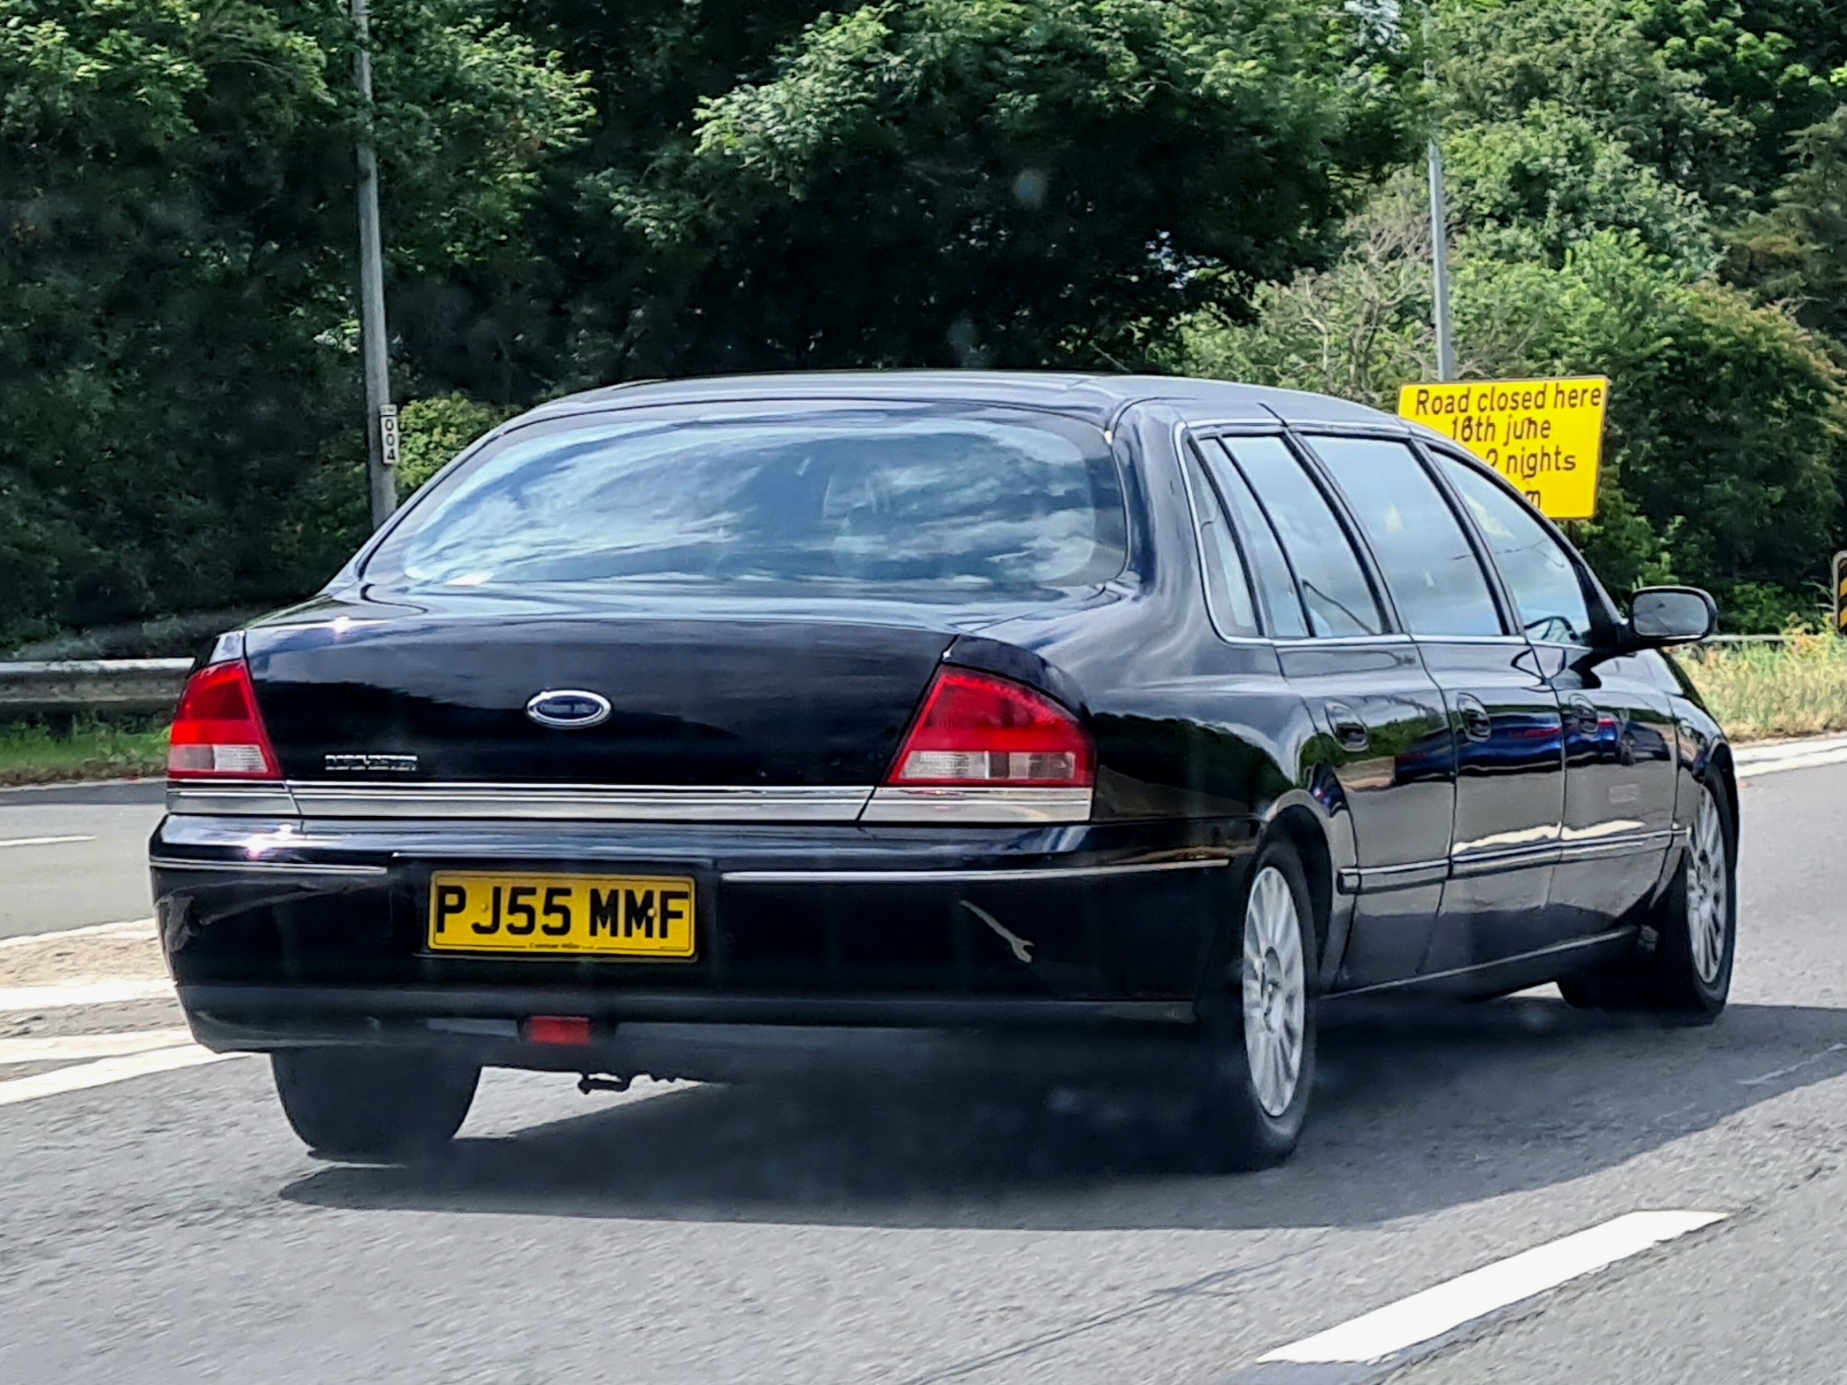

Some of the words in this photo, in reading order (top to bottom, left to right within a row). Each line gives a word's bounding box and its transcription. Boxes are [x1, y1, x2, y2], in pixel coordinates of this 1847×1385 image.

[1415, 388, 1472, 416] Road
[1477, 383, 1548, 413] closed
[1553, 382, 1602, 409] here
[1503, 413, 1551, 447] june
[1506, 444, 1577, 480] nights
[436, 884, 573, 936] PJ55
[589, 888, 689, 939] MMF
